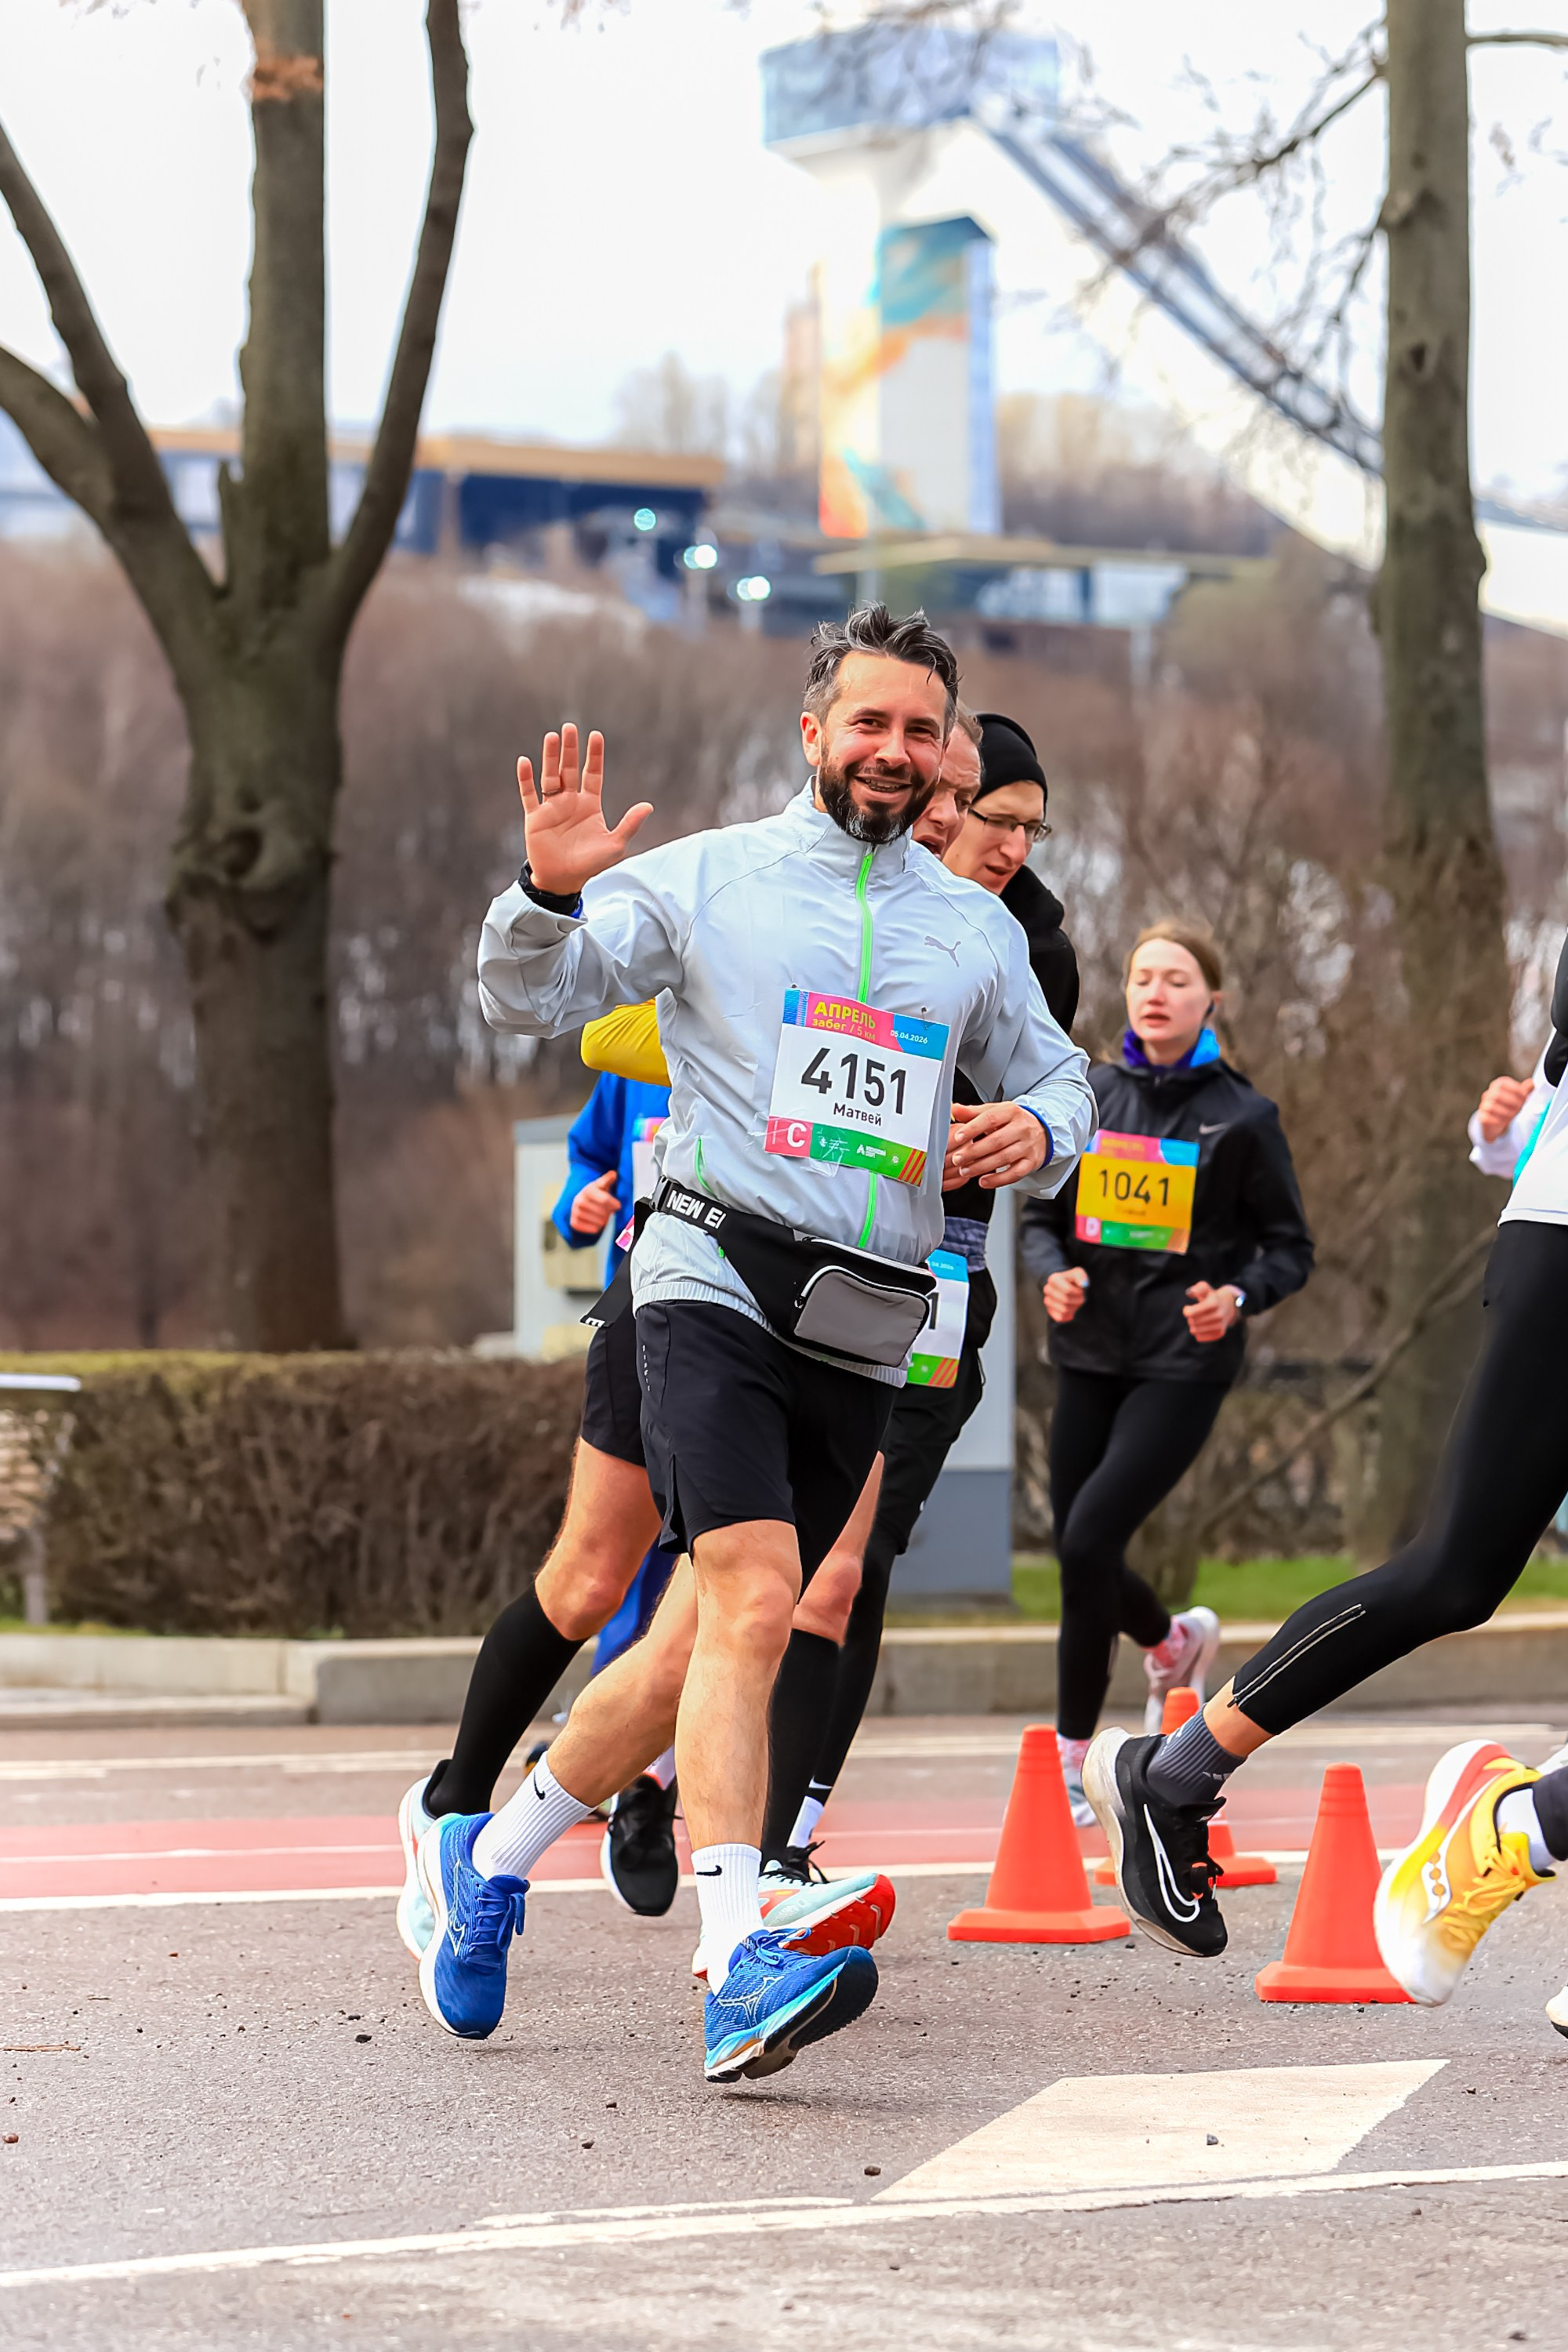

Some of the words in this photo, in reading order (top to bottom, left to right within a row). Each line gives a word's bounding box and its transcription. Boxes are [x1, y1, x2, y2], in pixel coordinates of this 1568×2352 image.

[811, 1018, 847, 1032] забег
[857, 1025, 862, 1036] 5
[814, 1001, 876, 1029] АПРЕЛЬ
[890, 1029, 928, 1044] 05.04.2026
[800, 1047, 906, 1115] 4151
[833, 1102, 882, 1127] Матвей
[1099, 1169, 1169, 1207] 1041
[666, 1189, 706, 1220] NEW
